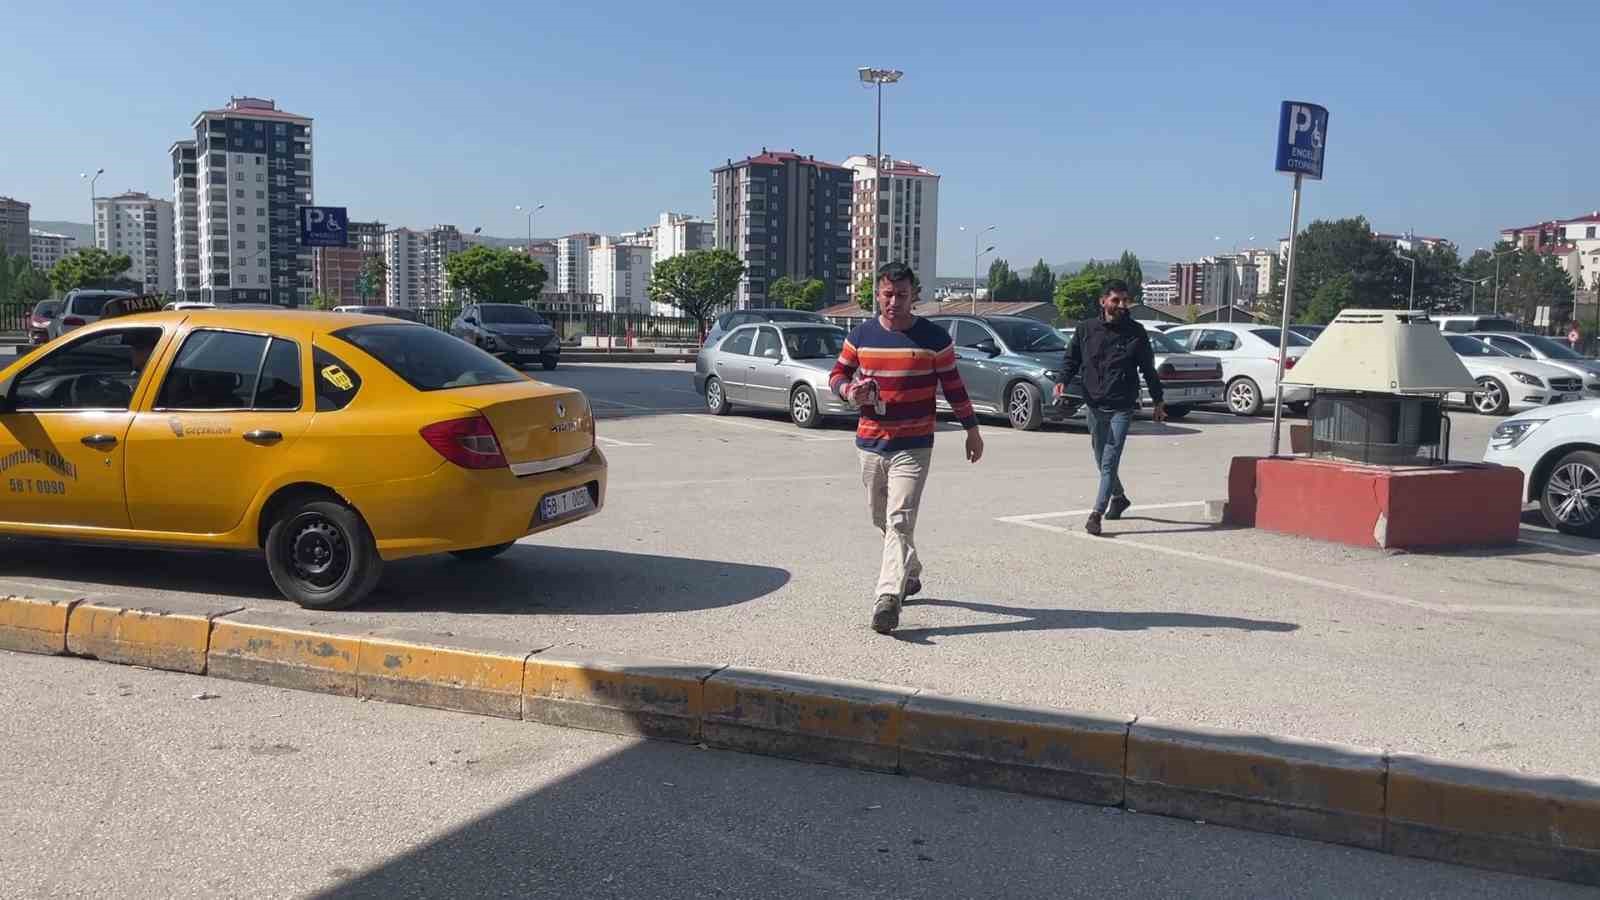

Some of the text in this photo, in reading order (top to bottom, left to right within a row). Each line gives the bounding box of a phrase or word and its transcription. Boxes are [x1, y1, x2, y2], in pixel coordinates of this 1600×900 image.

[1288, 104, 1312, 145] P
[305, 209, 324, 232] P
[545, 497, 558, 515] 58
[563, 494, 568, 511] T
